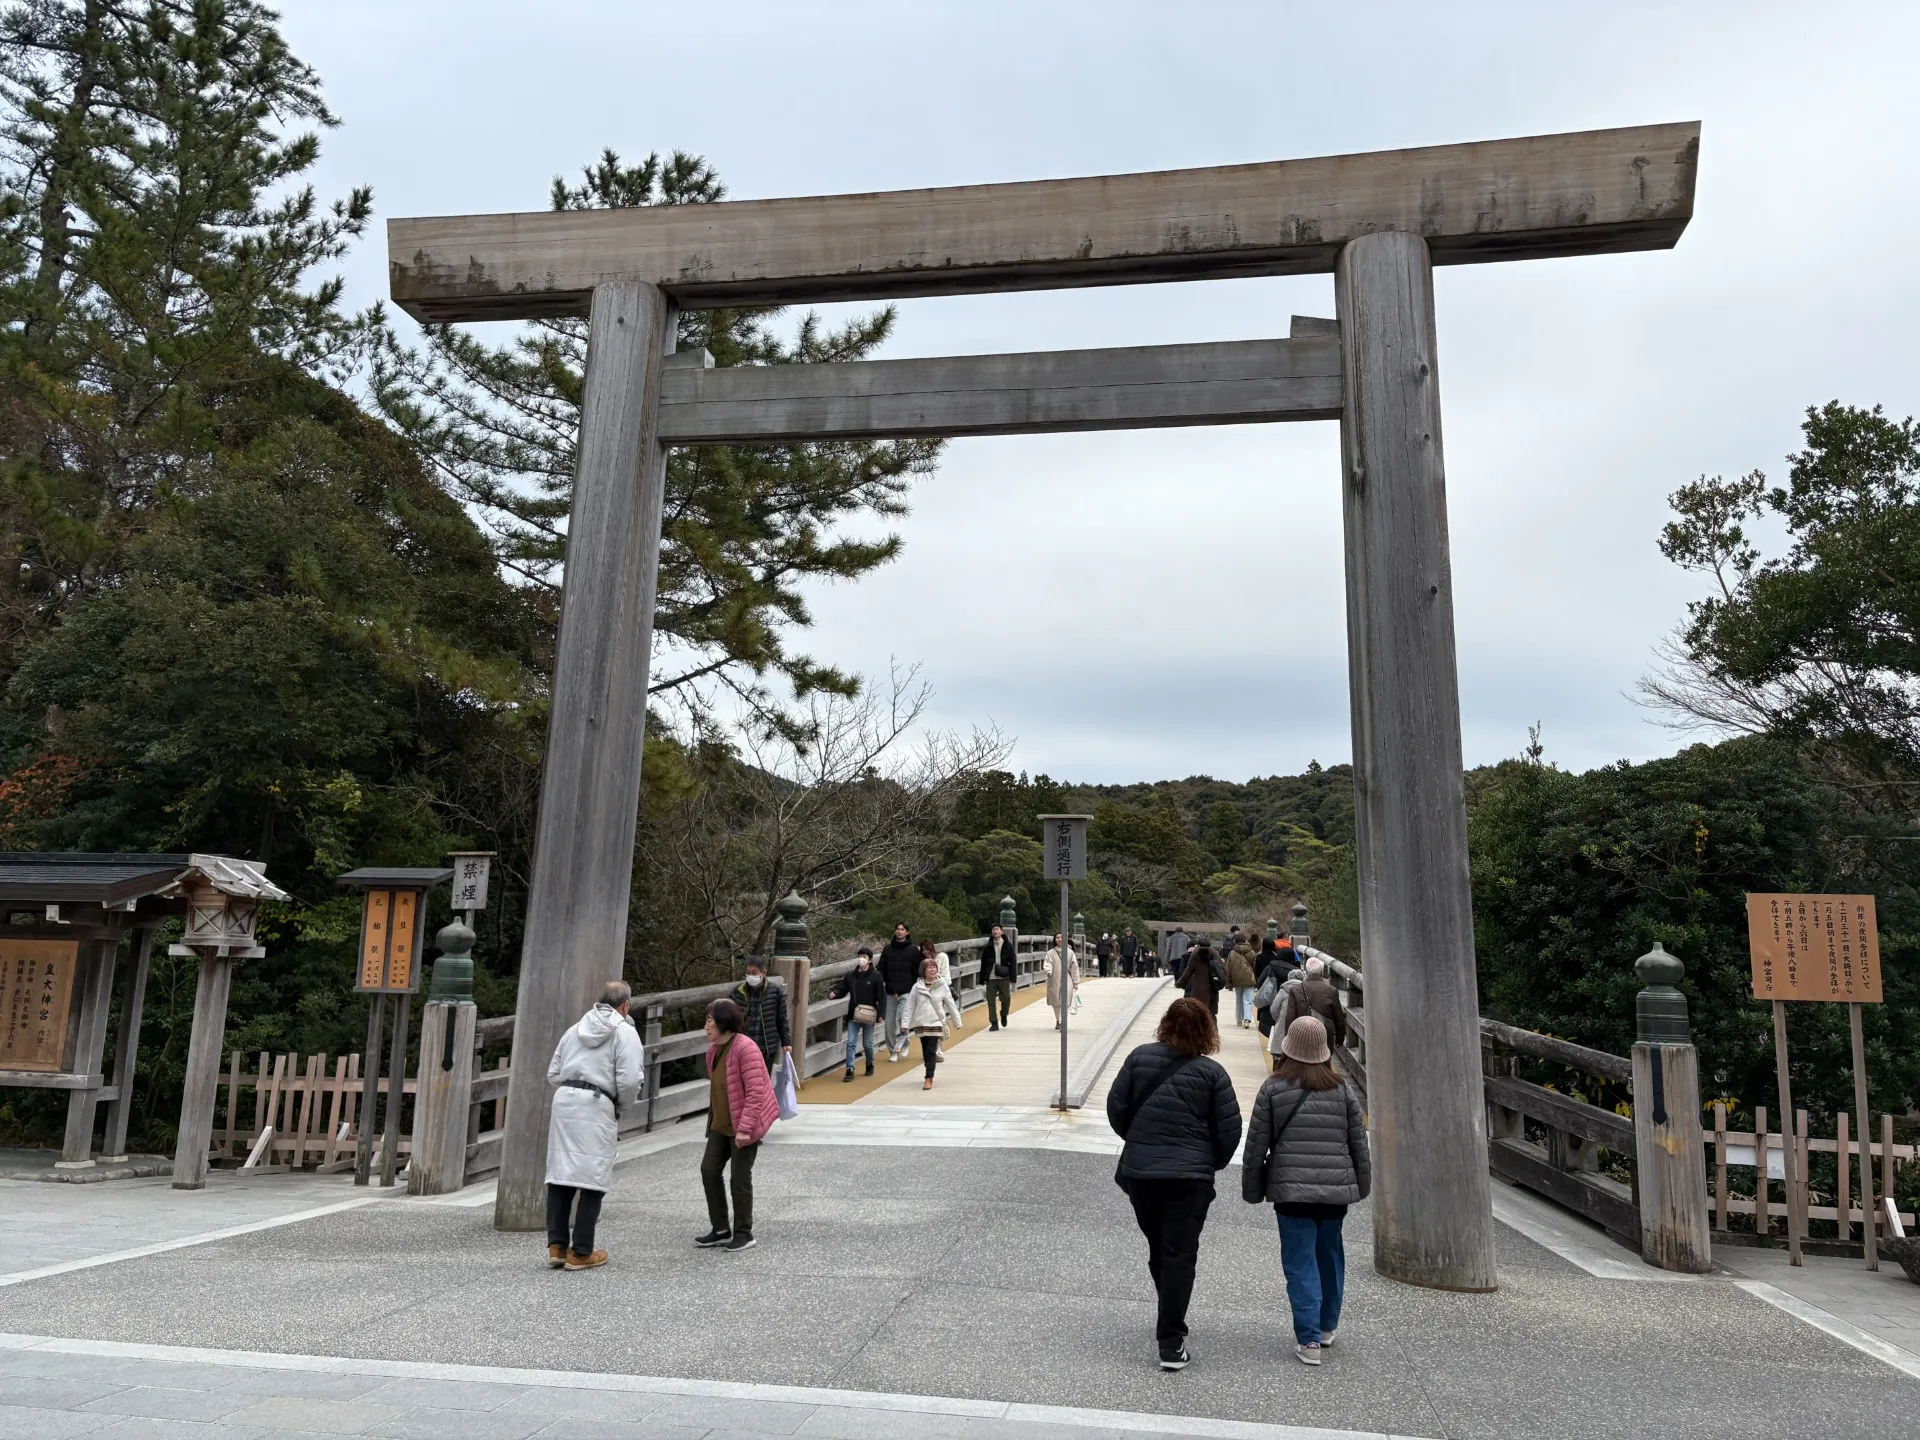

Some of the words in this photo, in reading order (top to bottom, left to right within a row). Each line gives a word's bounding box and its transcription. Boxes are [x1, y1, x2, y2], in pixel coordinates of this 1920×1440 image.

[1057, 821, 1072, 876] 右側通行
[462, 861, 478, 900] 禁煙
[371, 898, 383, 954] 元始祭
[1798, 901, 1808, 952] 五日から六日は
[1811, 900, 1820, 929] できます
[1784, 900, 1798, 988] 午前五時から午後八時まで
[39, 963, 55, 1021] 皇大神宮
[1763, 960, 1773, 992] 神宮司庁
